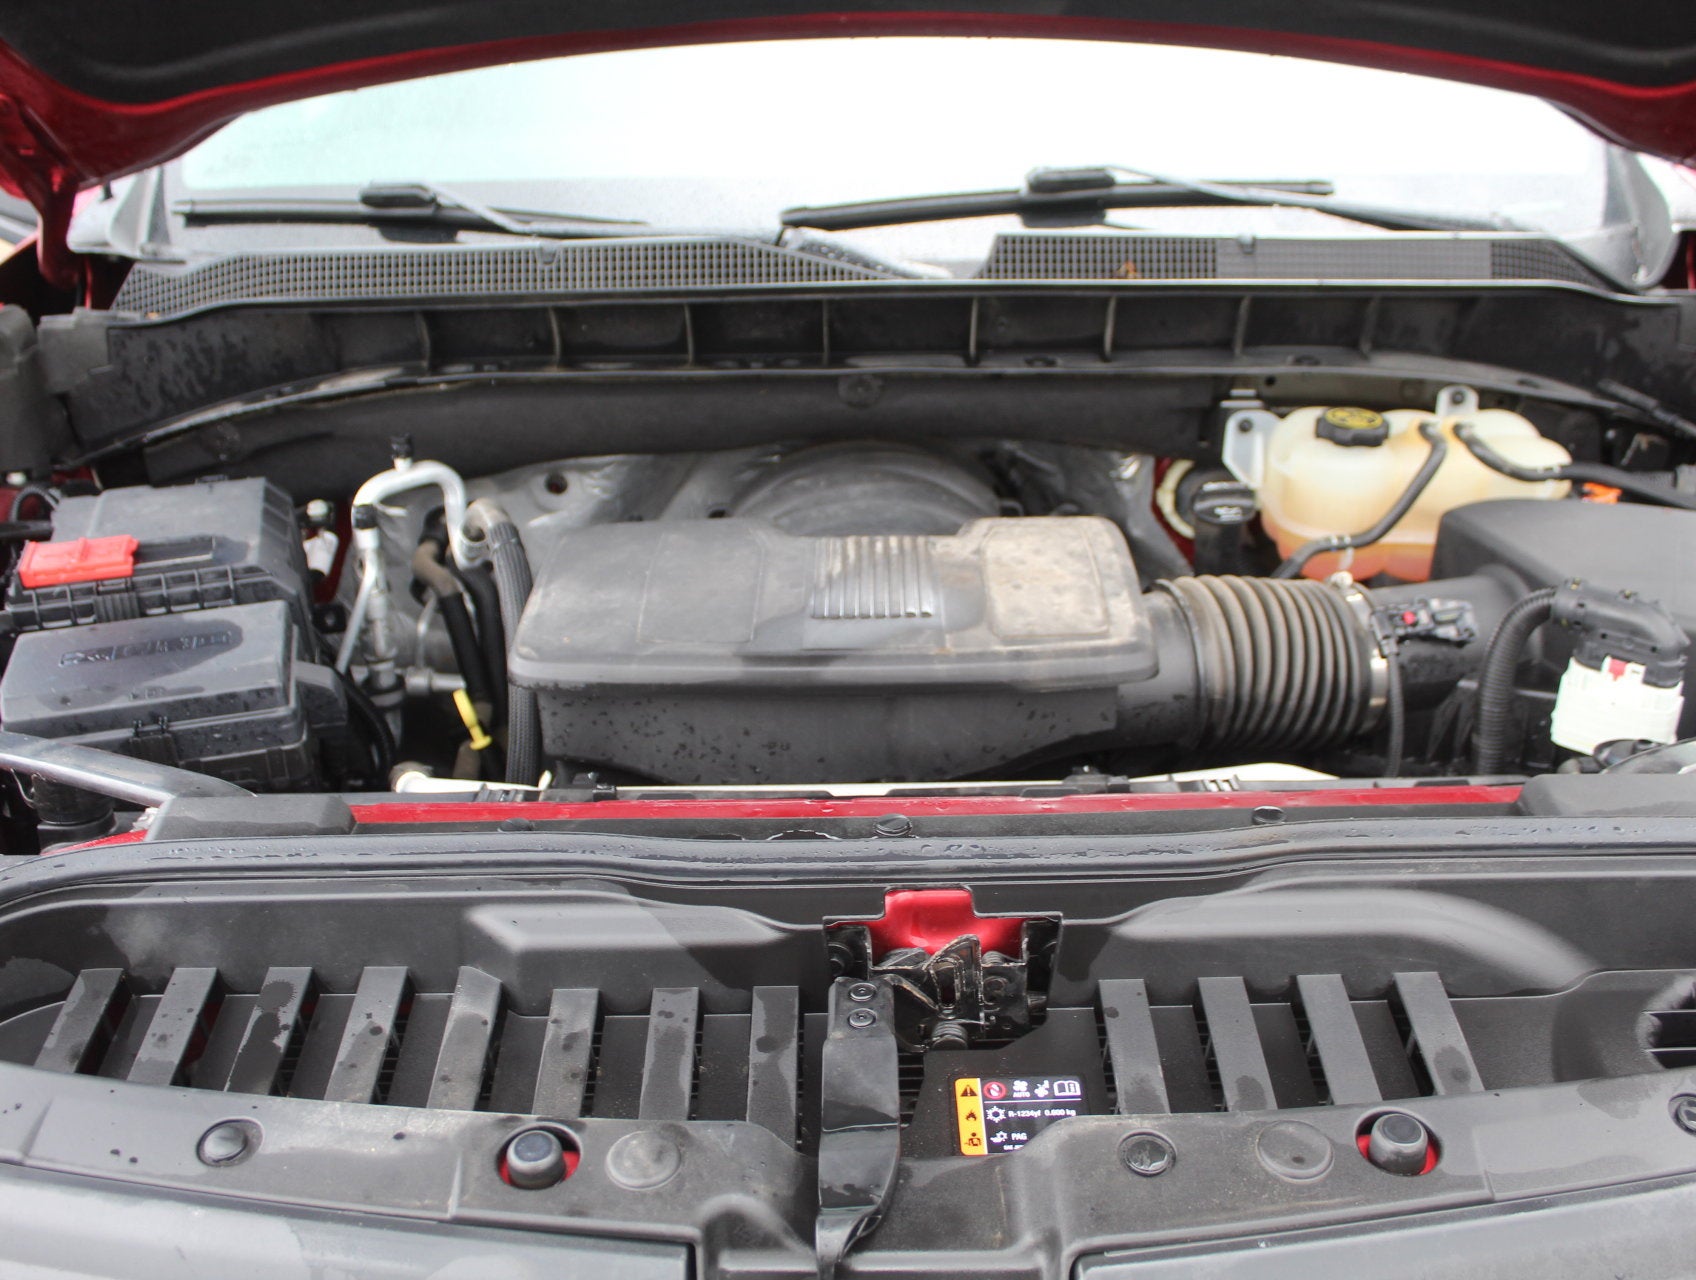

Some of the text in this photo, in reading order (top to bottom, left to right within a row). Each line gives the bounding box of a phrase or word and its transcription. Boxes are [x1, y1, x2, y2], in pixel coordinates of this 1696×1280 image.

[1008, 1109, 1041, 1118] R-1234yf
[1066, 1109, 1076, 1117] kg
[1011, 1132, 1027, 1140] PAG
